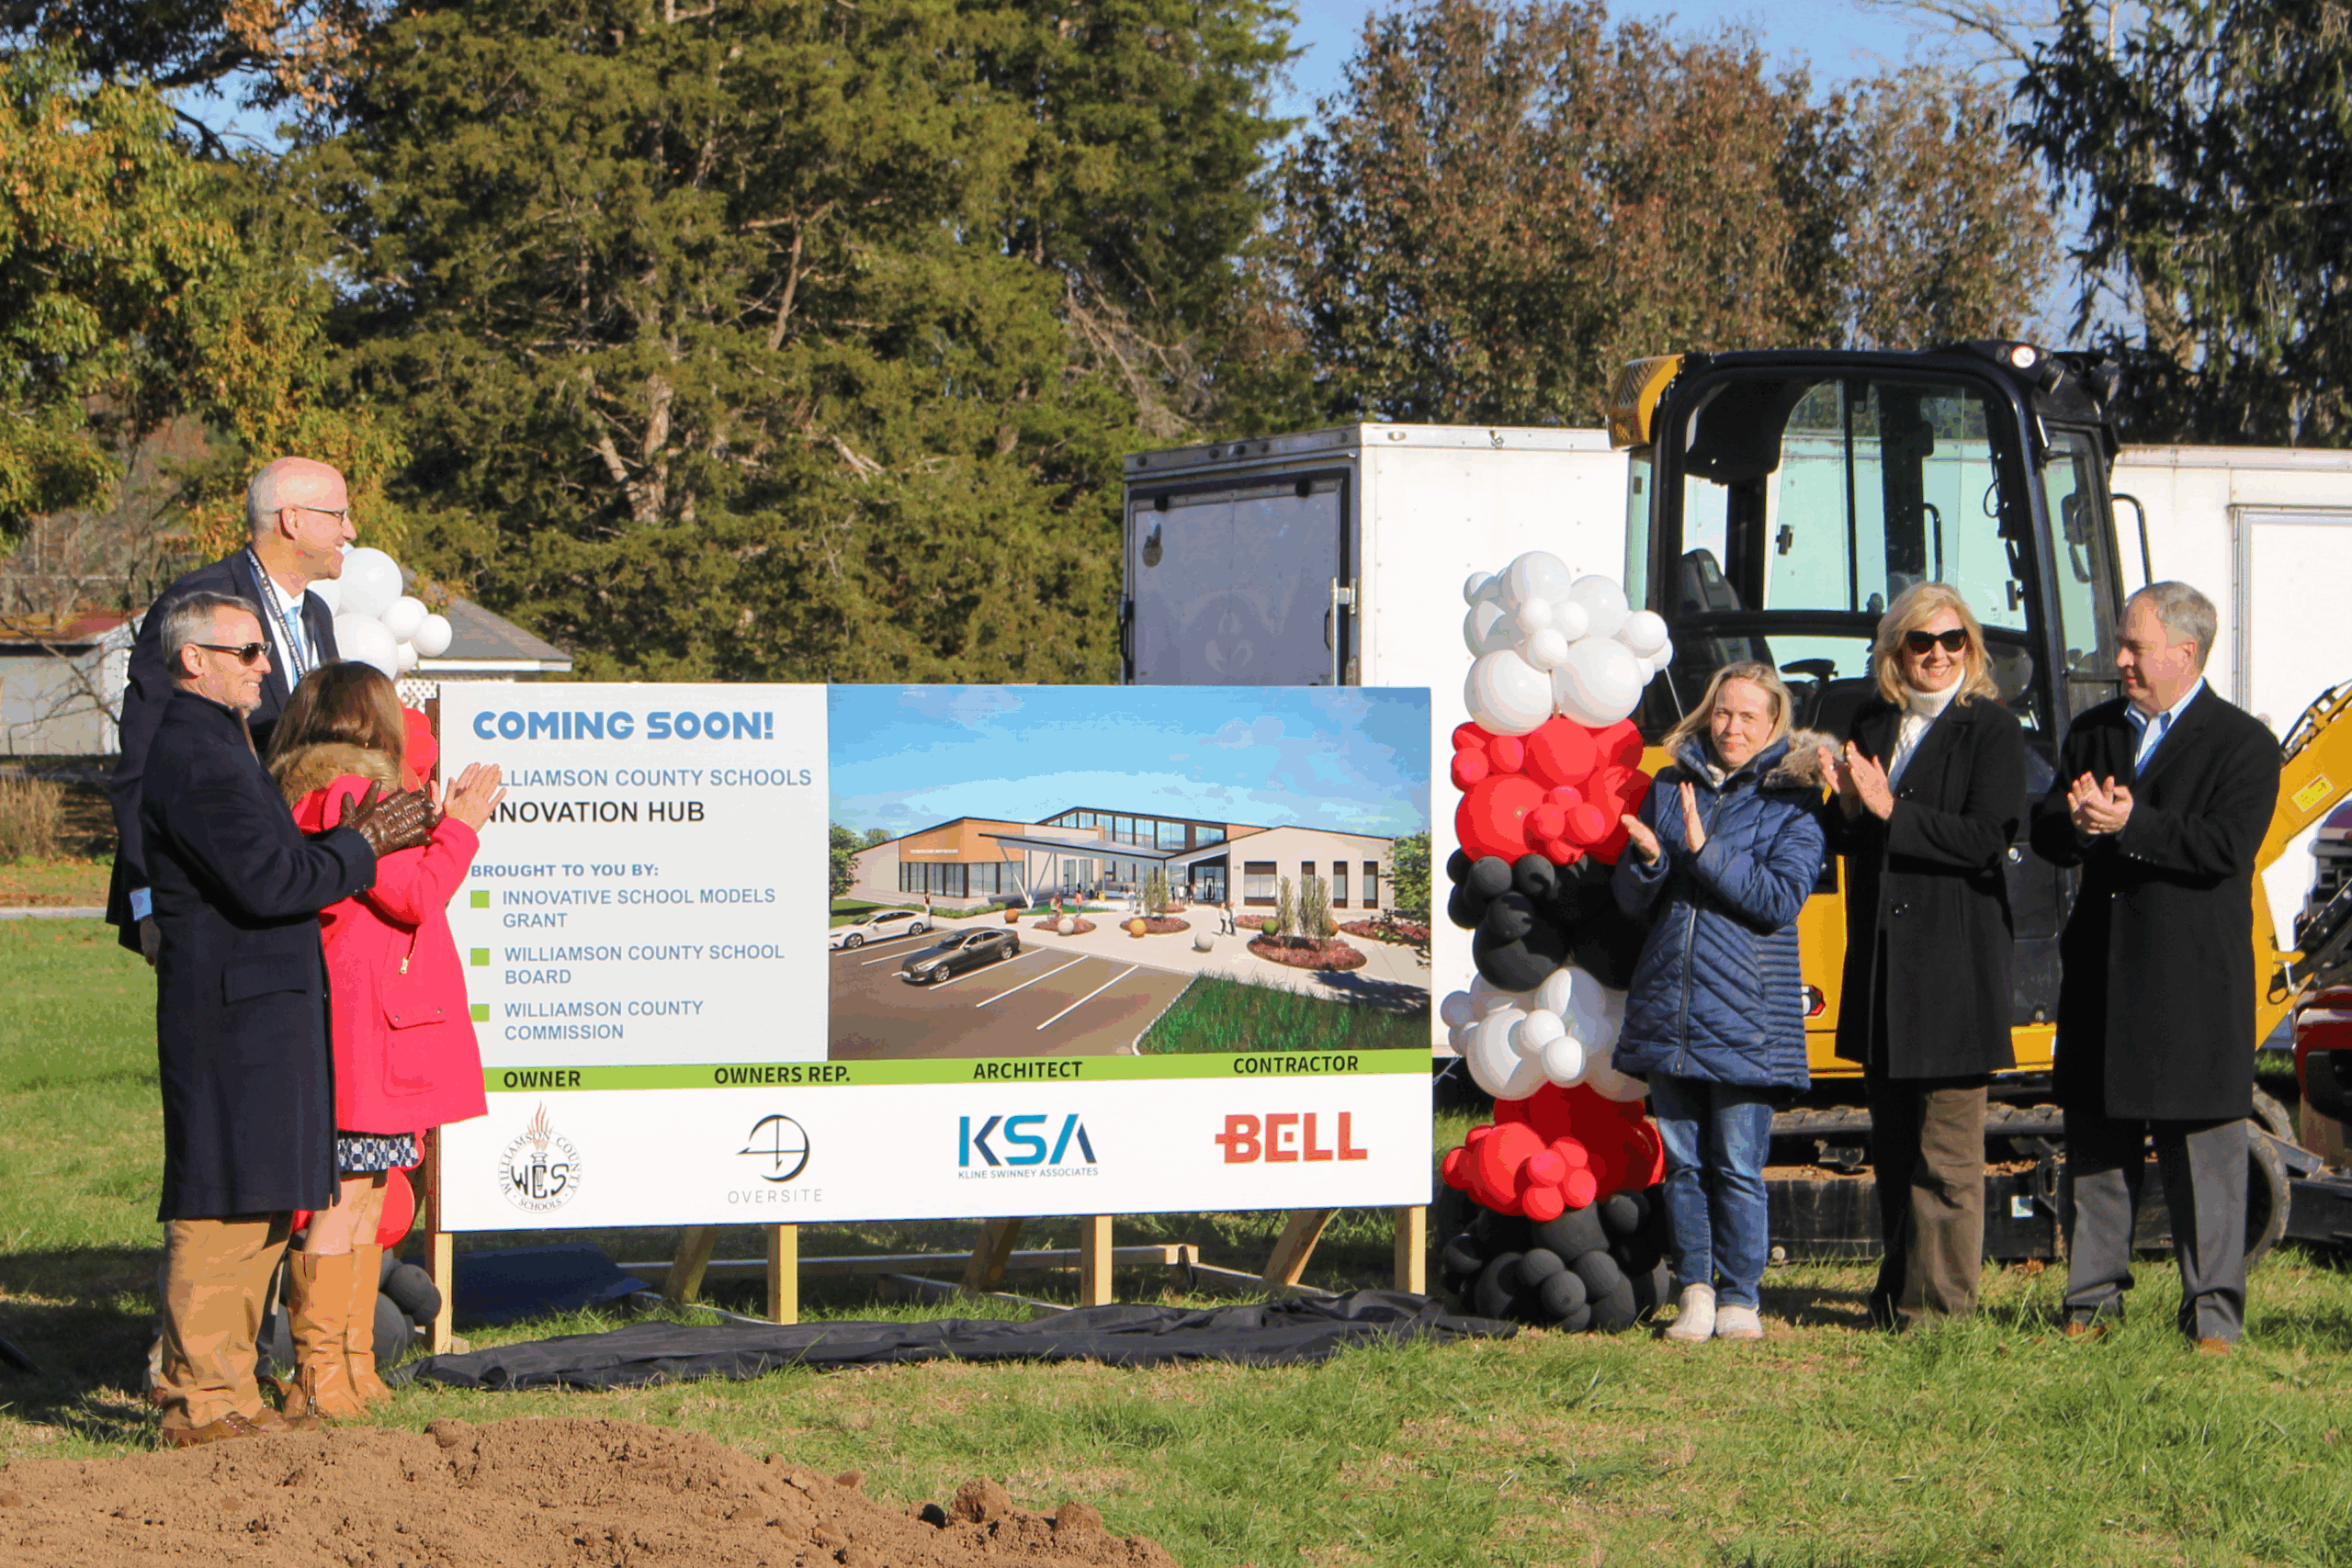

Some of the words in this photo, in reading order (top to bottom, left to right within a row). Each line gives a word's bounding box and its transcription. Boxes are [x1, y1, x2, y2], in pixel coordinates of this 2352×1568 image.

[264, 585, 282, 617] SCHOOLS
[472, 711, 635, 741] COMING
[646, 711, 775, 741] SOON!
[615, 769, 704, 786] COUNTY
[710, 768, 812, 786] SCHOOLS
[649, 801, 705, 822] HUB
[471, 864, 556, 877] BROUGHT
[561, 863, 585, 877] TO
[590, 863, 626, 876] YOU
[632, 863, 659, 876] BY:
[503, 889, 611, 905] INNOVATIVE
[617, 888, 694, 904] SCHOOL
[699, 887, 775, 903] MODELS
[503, 912, 568, 928] GRANT
[504, 946, 621, 962] WILLIAMSON
[628, 945, 704, 961] COUNTY
[709, 944, 785, 960] SCHOOL
[504, 969, 571, 985] BOARD
[504, 1002, 621, 1018] WILLIAMSON
[628, 1000, 704, 1017] COUNTY
[504, 1024, 624, 1041] COMMISSION
[973, 1061, 1083, 1079] ARCHITECT
[1233, 1055, 1359, 1074] CONTRACTOR
[503, 1070, 581, 1088] OWNER
[714, 1066, 802, 1085] OWNERS
[808, 1066, 851, 1083] REP.
[959, 1113, 1097, 1167] KSA
[1215, 1111, 1368, 1164] BELL
[500, 1131, 550, 1195] WILLIAMSON
[556, 1137, 580, 1192] COUNTY
[511, 1164, 569, 1199] WCS
[958, 1169, 988, 1179] KLINE
[990, 1168, 1036, 1179] SWINNEY
[1039, 1168, 1099, 1178] ASSOCIATES
[518, 1198, 562, 1211] SCHOOLS
[728, 1189, 822, 1204] OVERSITE
